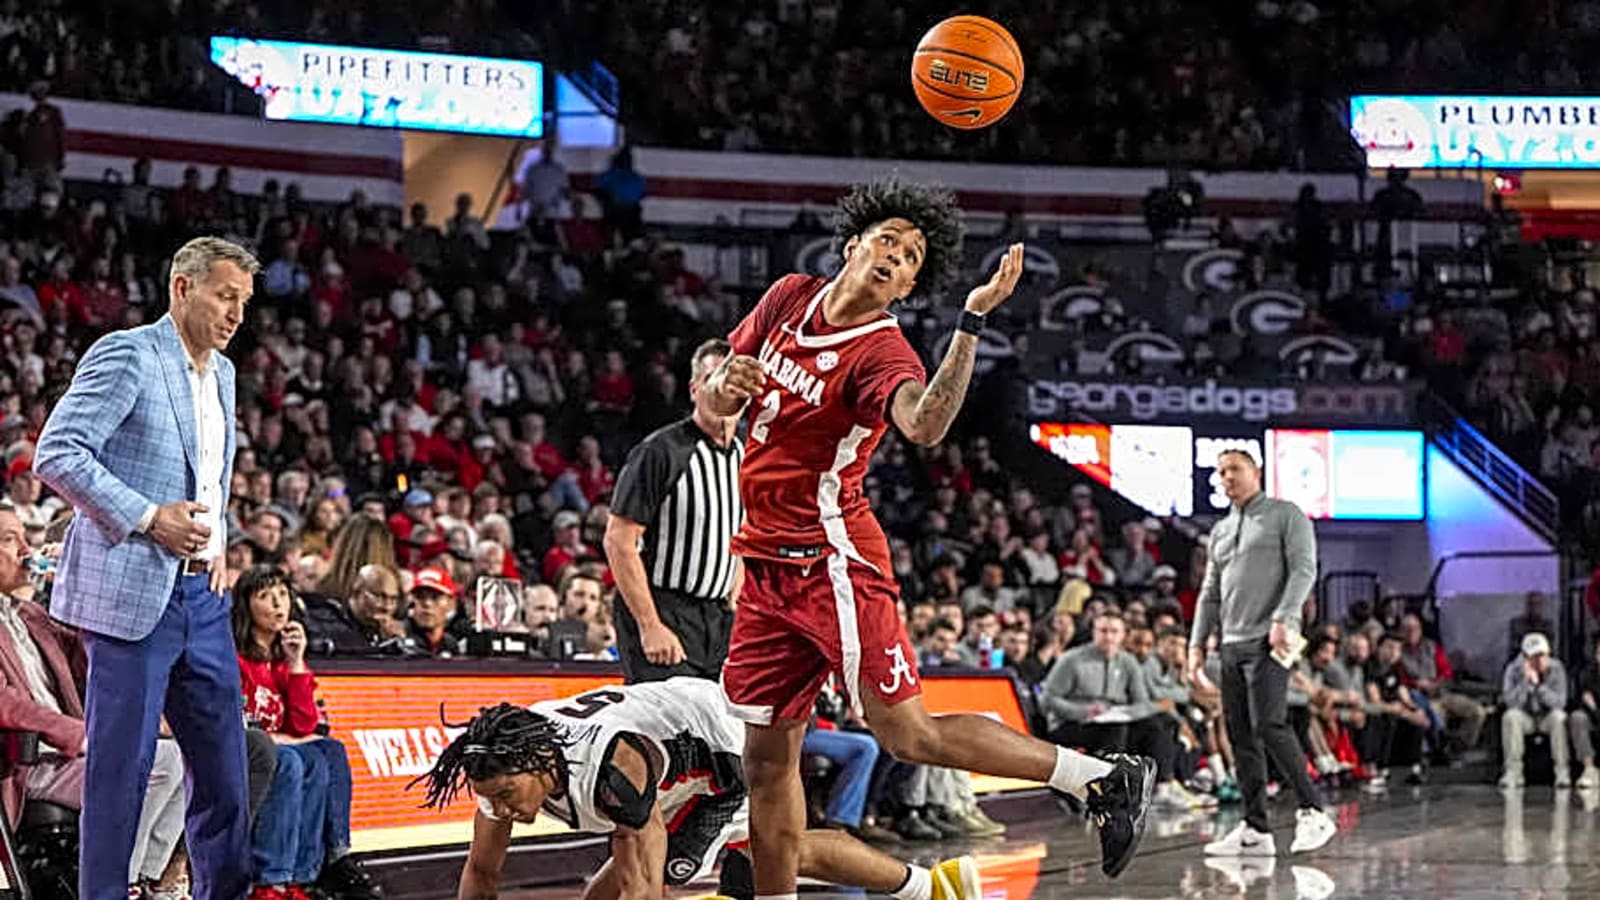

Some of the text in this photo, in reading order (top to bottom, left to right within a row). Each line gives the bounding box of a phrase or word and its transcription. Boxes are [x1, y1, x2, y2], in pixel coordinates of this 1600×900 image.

[302, 52, 527, 90] PIPEFITTERS
[929, 60, 989, 93] ELITE
[751, 389, 781, 445] 2
[879, 642, 916, 694] A
[553, 690, 625, 720] 5
[351, 726, 446, 778] WELLS
